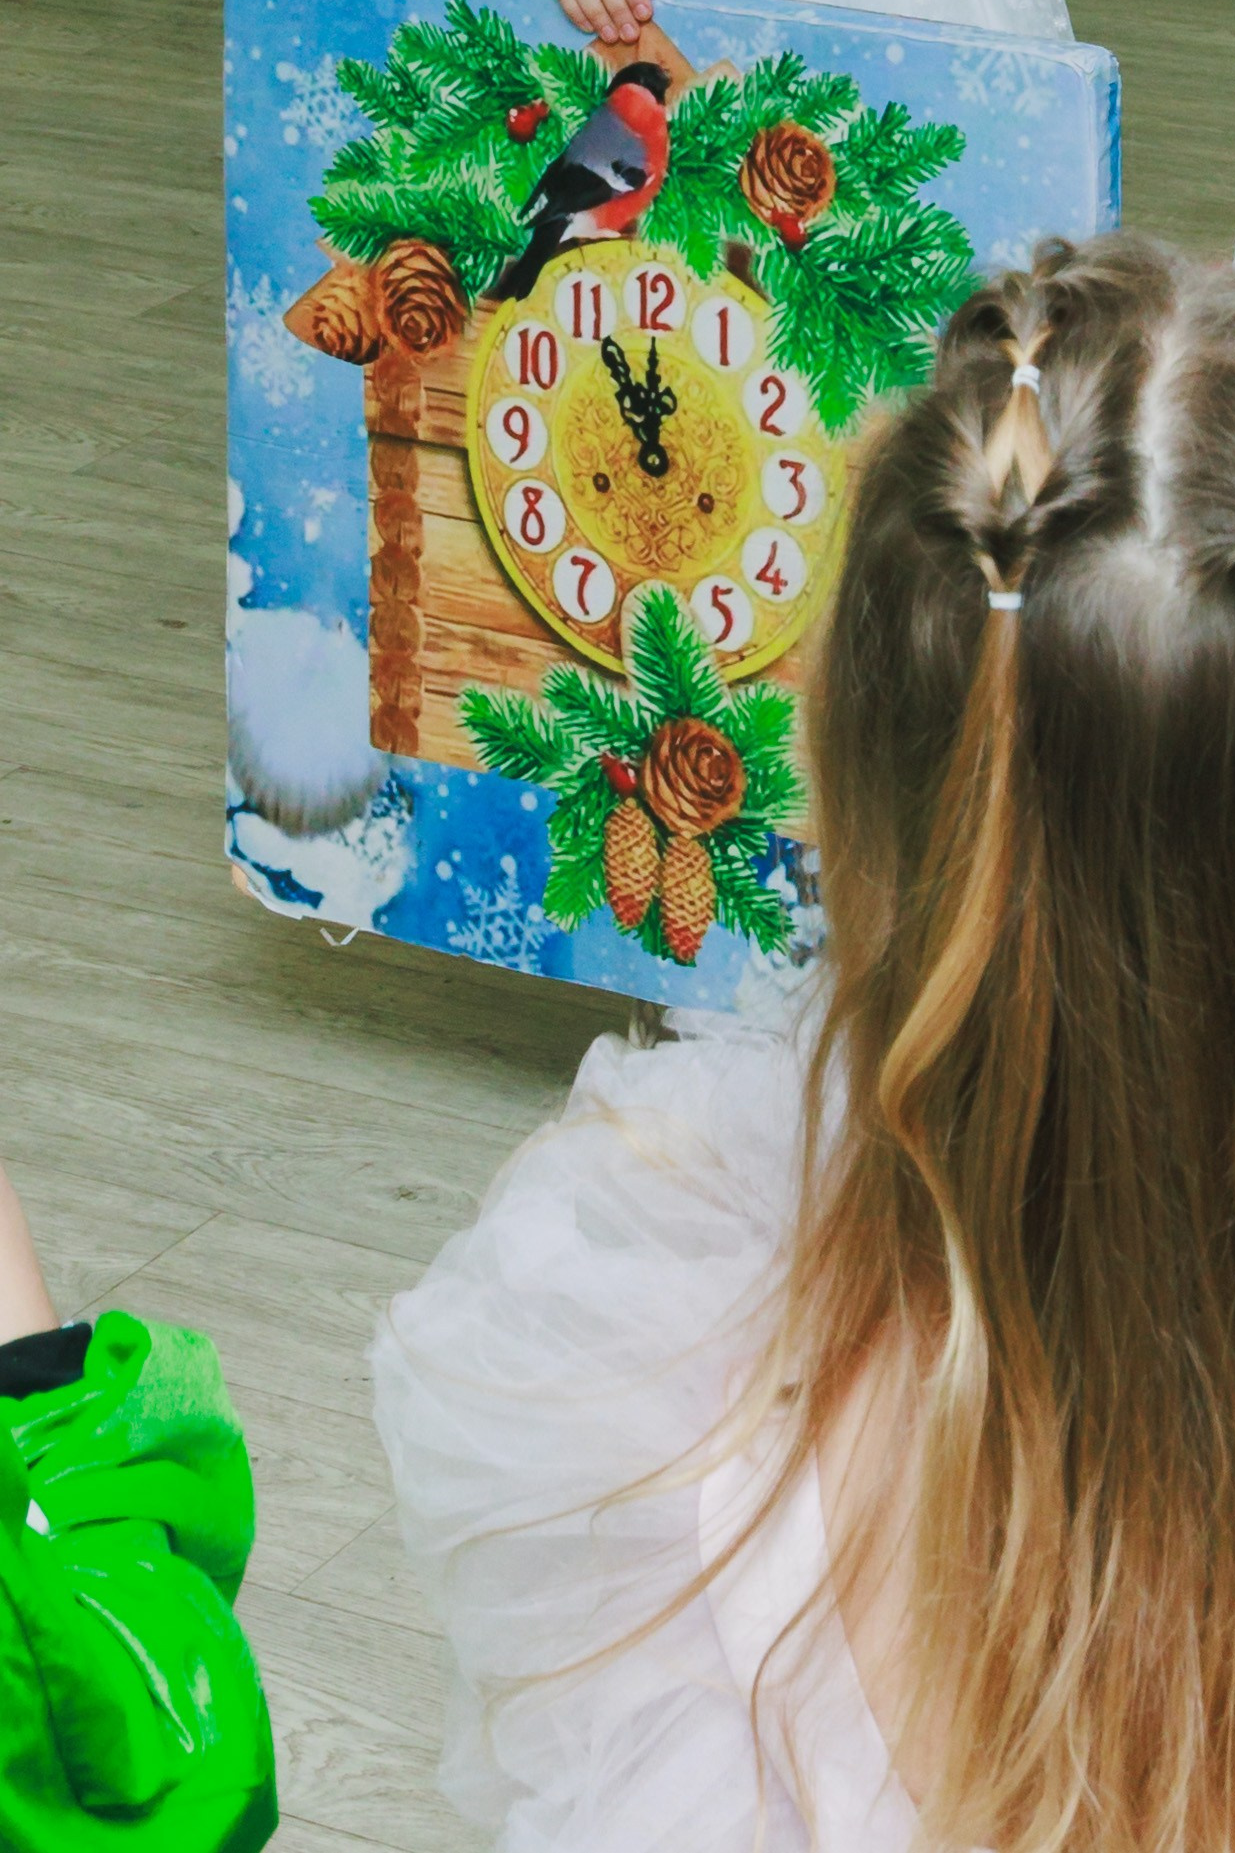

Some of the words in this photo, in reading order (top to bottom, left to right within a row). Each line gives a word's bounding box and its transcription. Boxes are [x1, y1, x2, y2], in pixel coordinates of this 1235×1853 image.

[572, 281, 601, 341] 11
[636, 272, 675, 331] 12
[518, 328, 557, 390] 10
[717, 306, 729, 366] 1
[504, 406, 529, 463] 9
[760, 376, 786, 435] 2
[520, 487, 545, 545] 8
[779, 460, 806, 520] 3
[570, 555, 596, 615] 7
[756, 541, 787, 596] 4
[711, 585, 733, 644] 5
